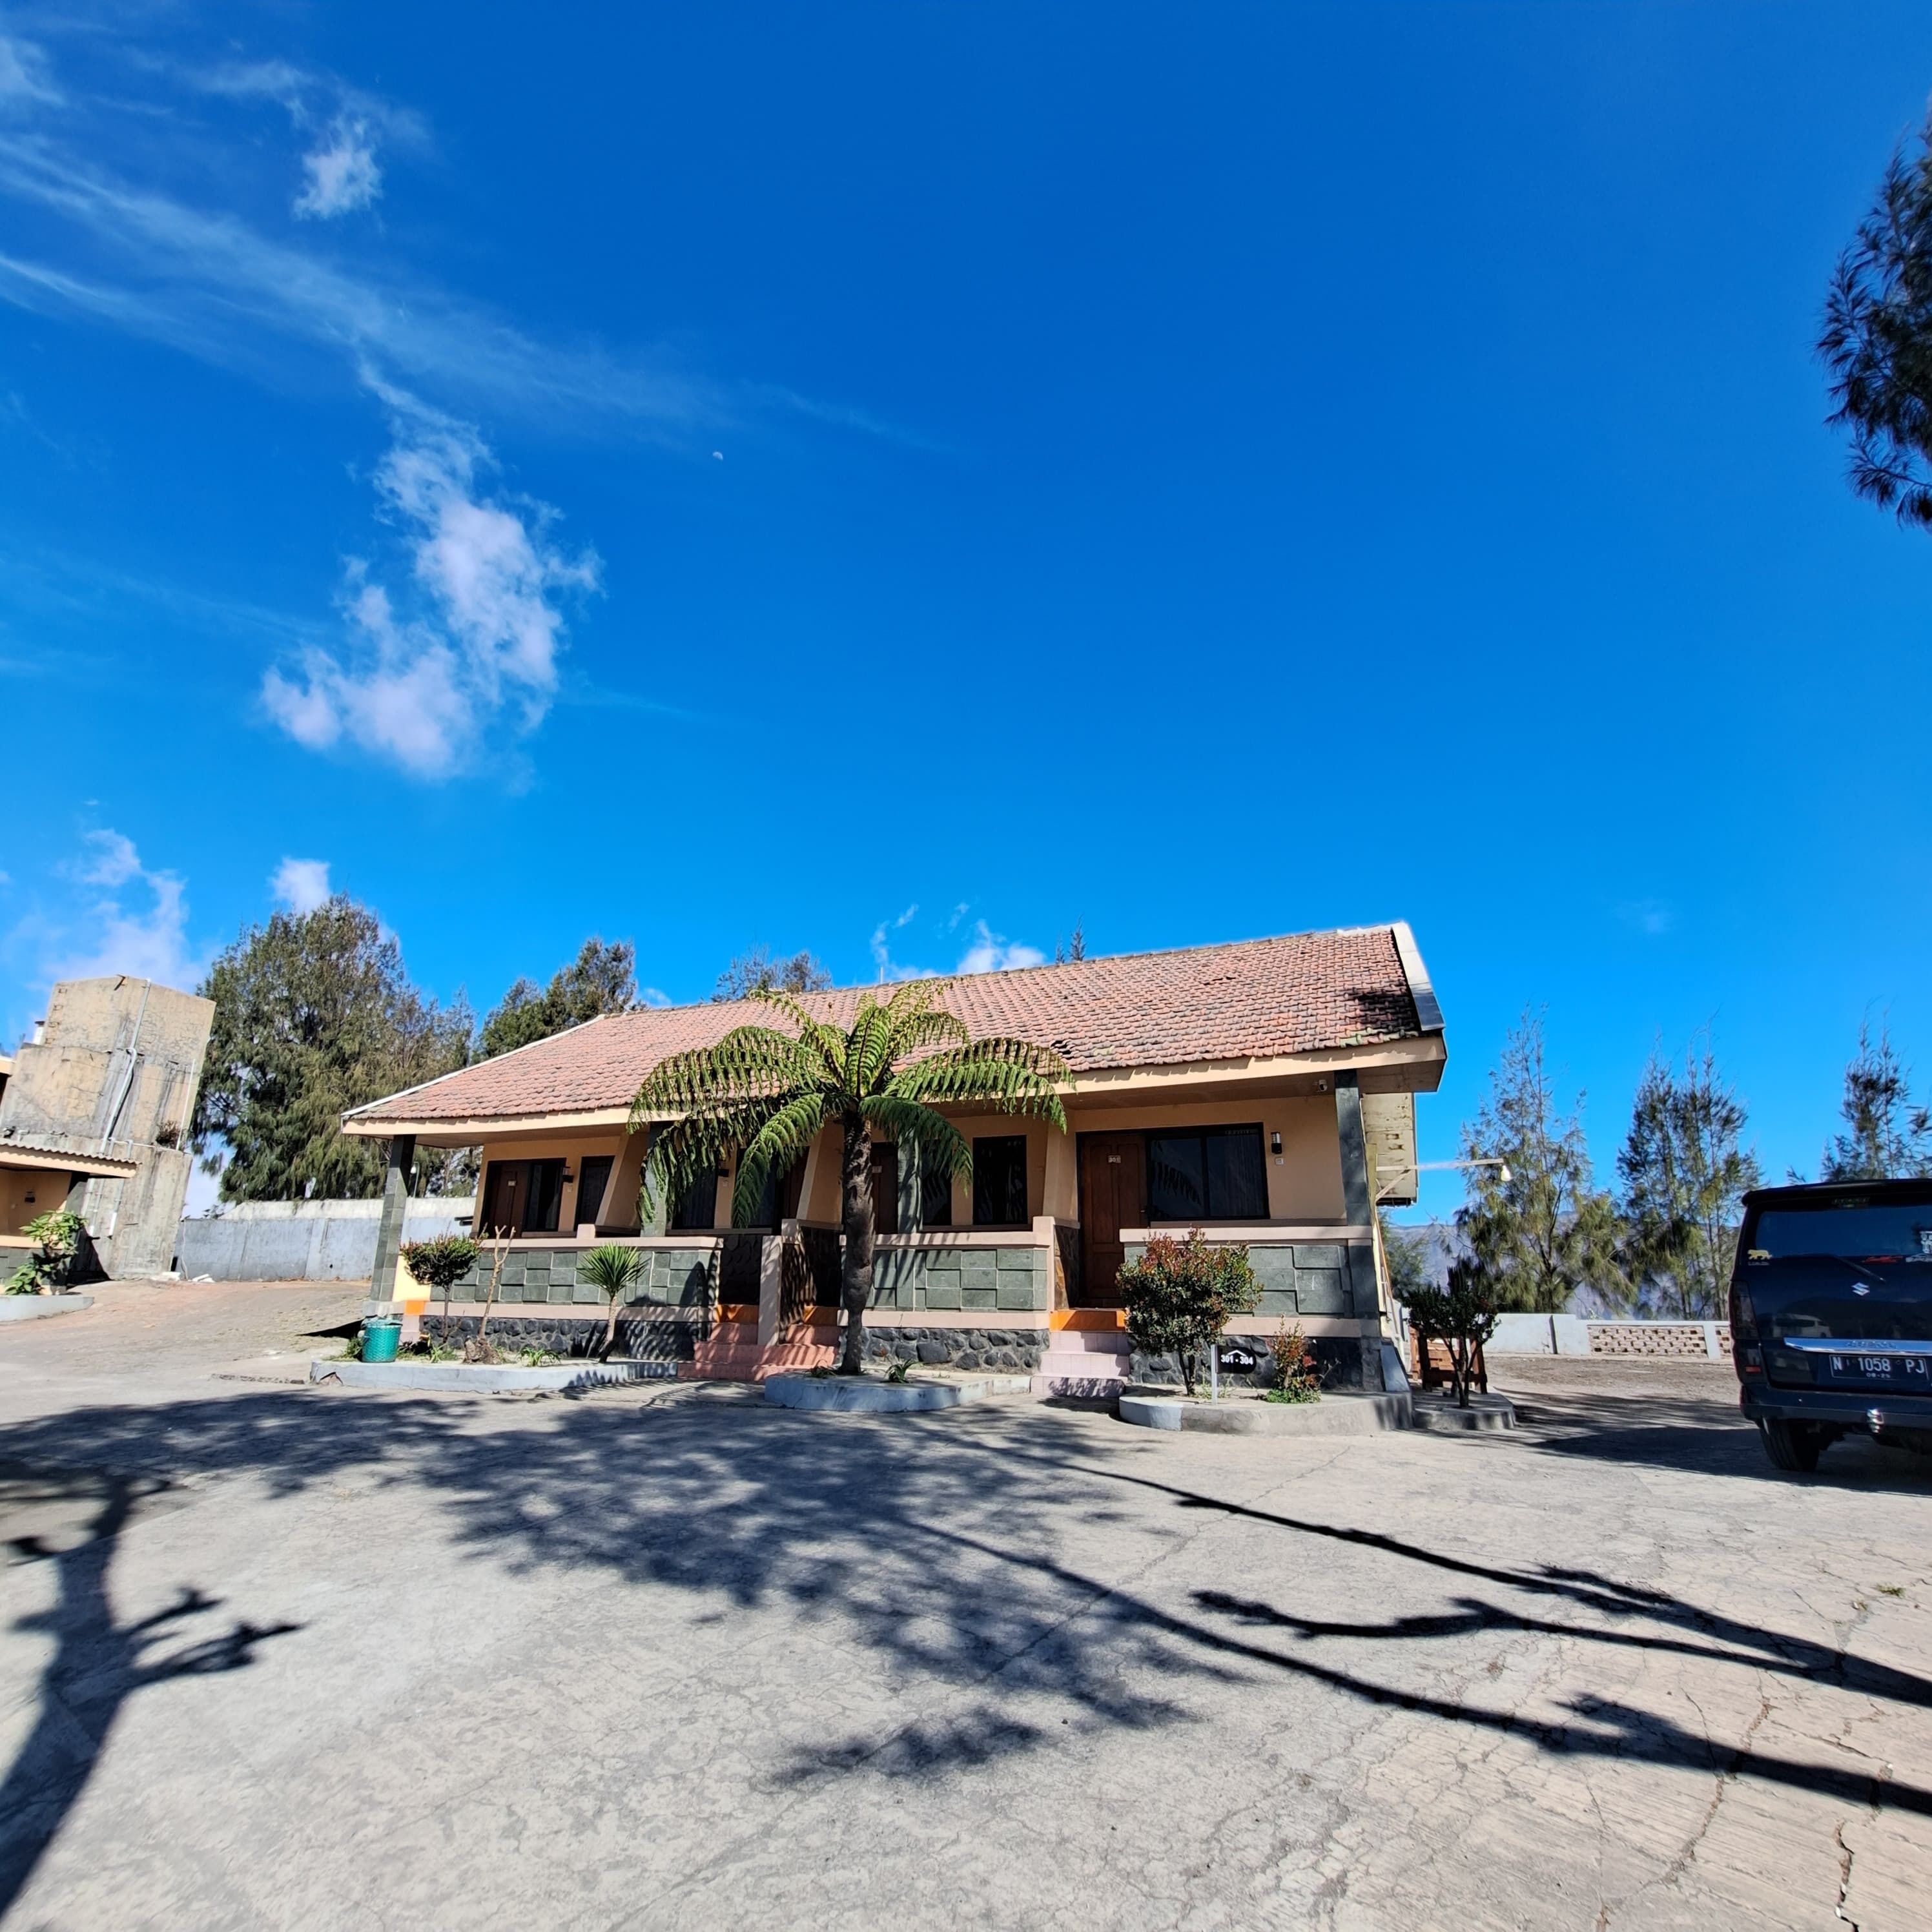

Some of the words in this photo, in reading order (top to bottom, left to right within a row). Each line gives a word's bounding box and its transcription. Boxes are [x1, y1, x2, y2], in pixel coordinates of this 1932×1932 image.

[1220, 1355, 1234, 1363] 301
[1240, 1357, 1253, 1365] 304
[1832, 1356, 1842, 1369] N
[1858, 1357, 1891, 1372] 1058
[1906, 1359, 1925, 1373] PJ
